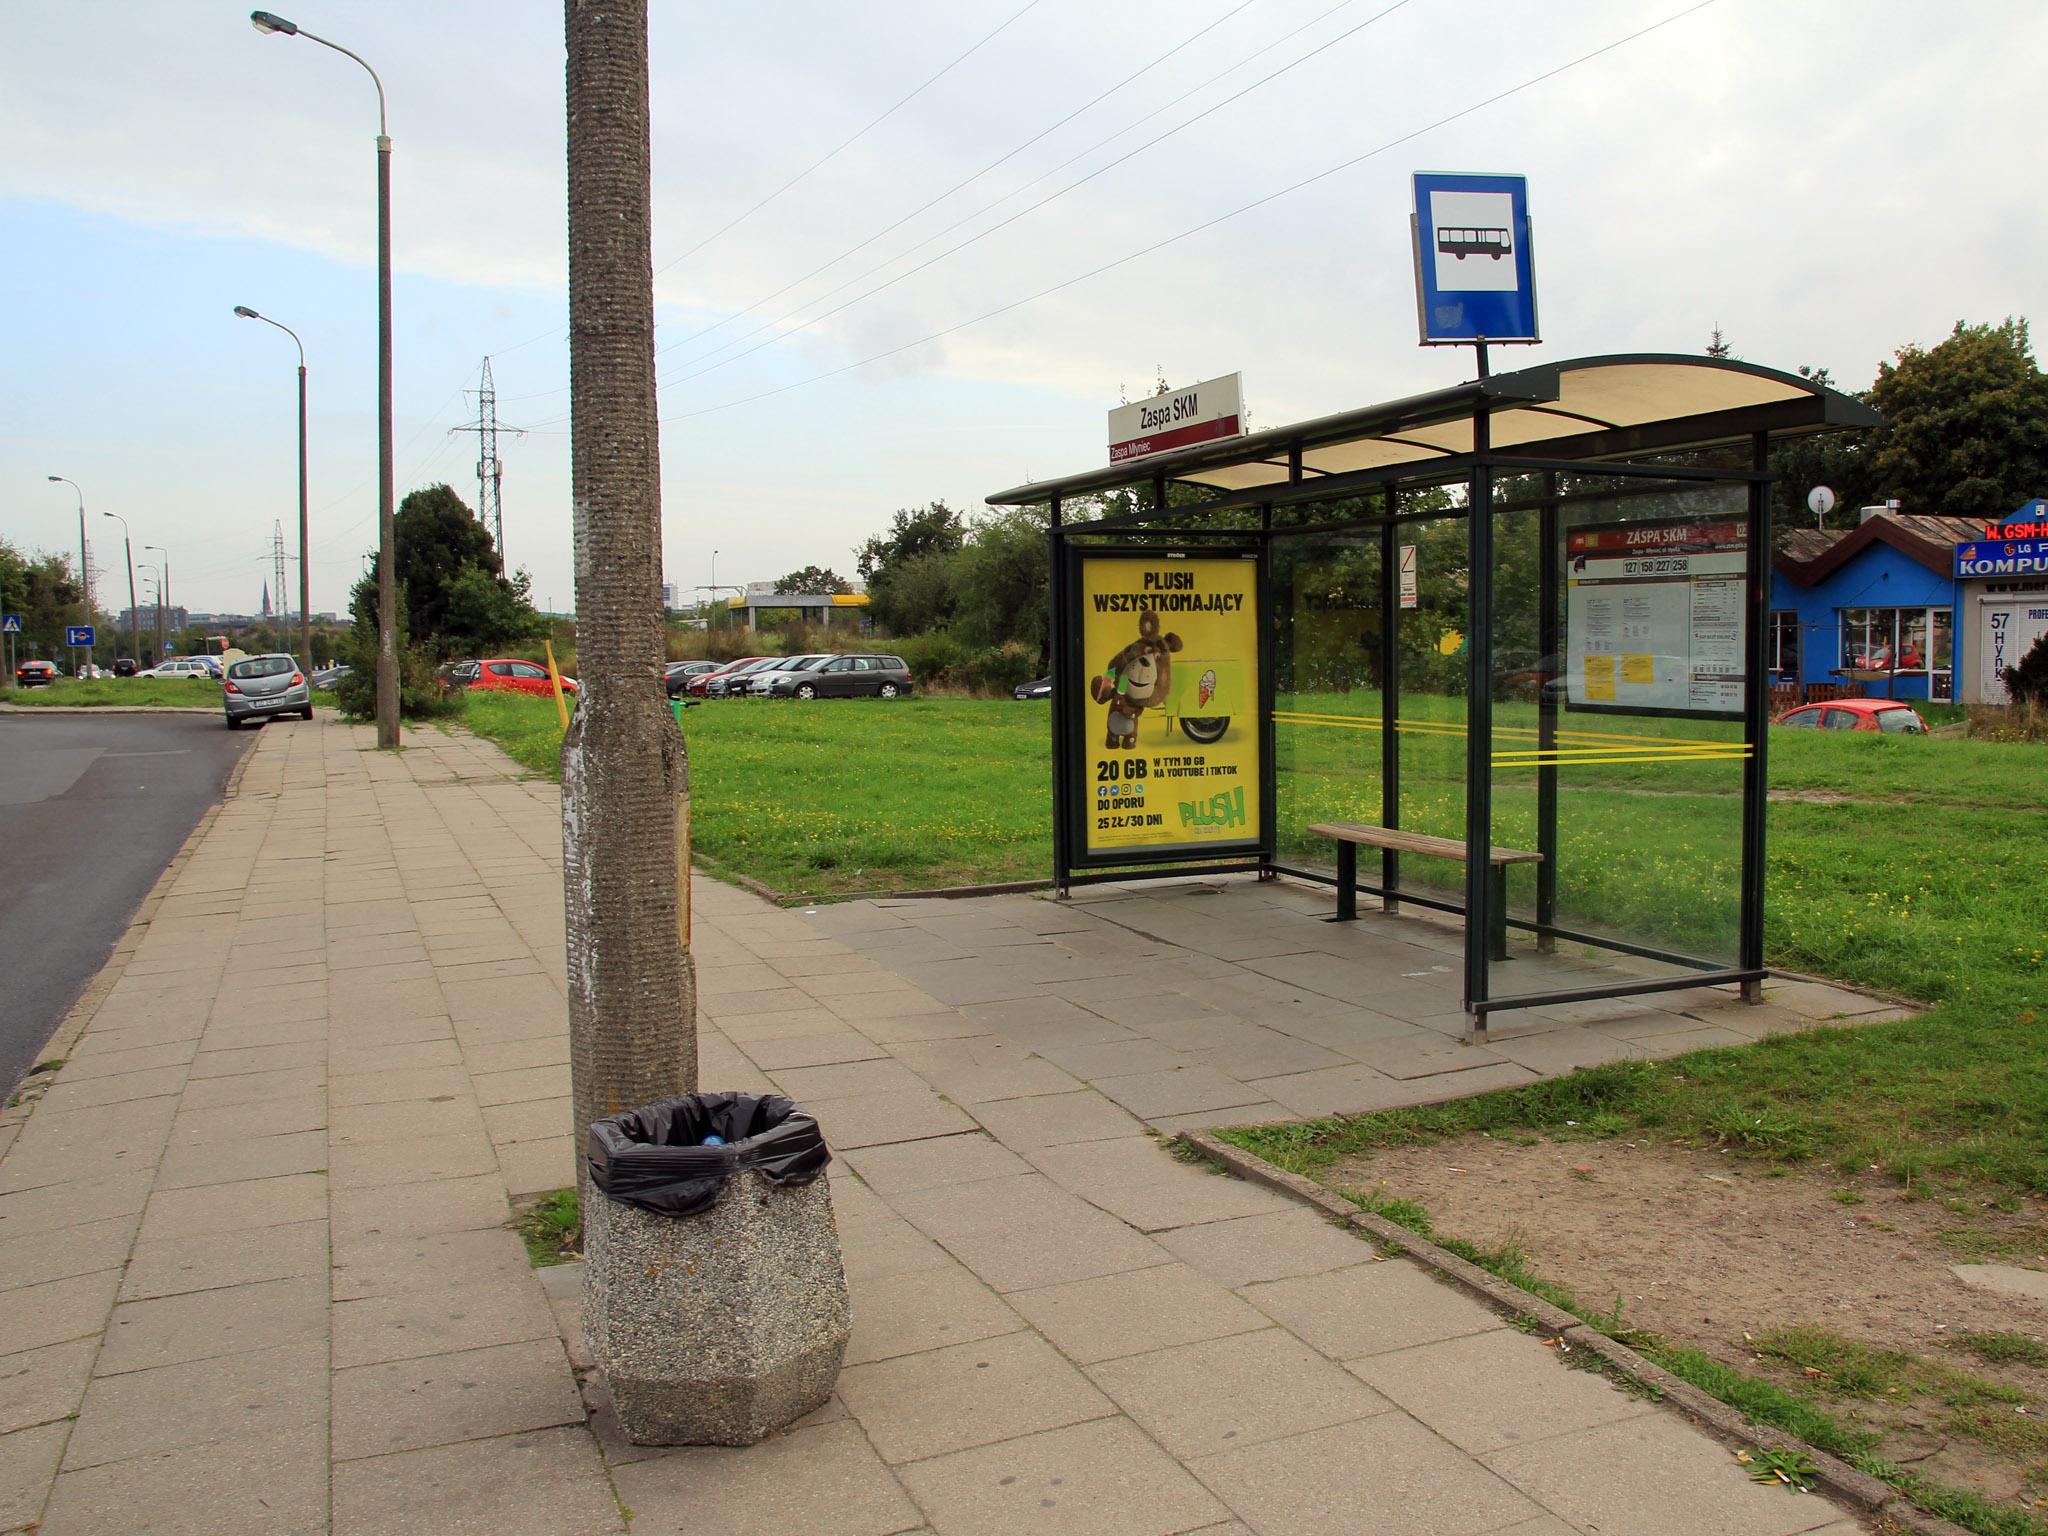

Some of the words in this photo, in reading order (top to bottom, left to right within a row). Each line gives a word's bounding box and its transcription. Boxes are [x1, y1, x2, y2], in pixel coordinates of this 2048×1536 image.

[1140, 406, 1171, 430] Zaspa
[1173, 393, 1199, 421] SKM
[1110, 446, 1128, 460] Zaspa
[1626, 530, 1661, 545] ZASPA
[1663, 528, 1687, 543] SKM
[2017, 544, 2032, 554] LG
[1624, 561, 1638, 573] 127
[1641, 561, 1654, 572] 158
[1655, 560, 1670, 572] 227
[1672, 559, 1688, 571] 258
[1143, 572, 1194, 590] PLUSH
[1093, 593, 1244, 616] WSZYSTKOMAJĄCY
[1991, 612, 2010, 629] 57
[1097, 760, 1119, 781] 20
[1123, 758, 1148, 779] GB
[1153, 758, 1161, 767] W
[1163, 757, 1180, 767] TYM
[1182, 756, 1192, 766] 10
[1193, 756, 1205, 766] GB
[1153, 768, 1165, 778] NA
[1167, 766, 1204, 777] YOUTUBE
[1205, 766, 1209, 776] I
[1210, 765, 1238, 776] TIKTOK
[1097, 799, 1110, 811] DO
[1112, 797, 1145, 810] OPORU
[1178, 786, 1246, 828] PLUSH
[1097, 817, 1110, 829] 25
[1111, 815, 1144, 829] ZŁ/30
[1146, 814, 1163, 826] DNI
